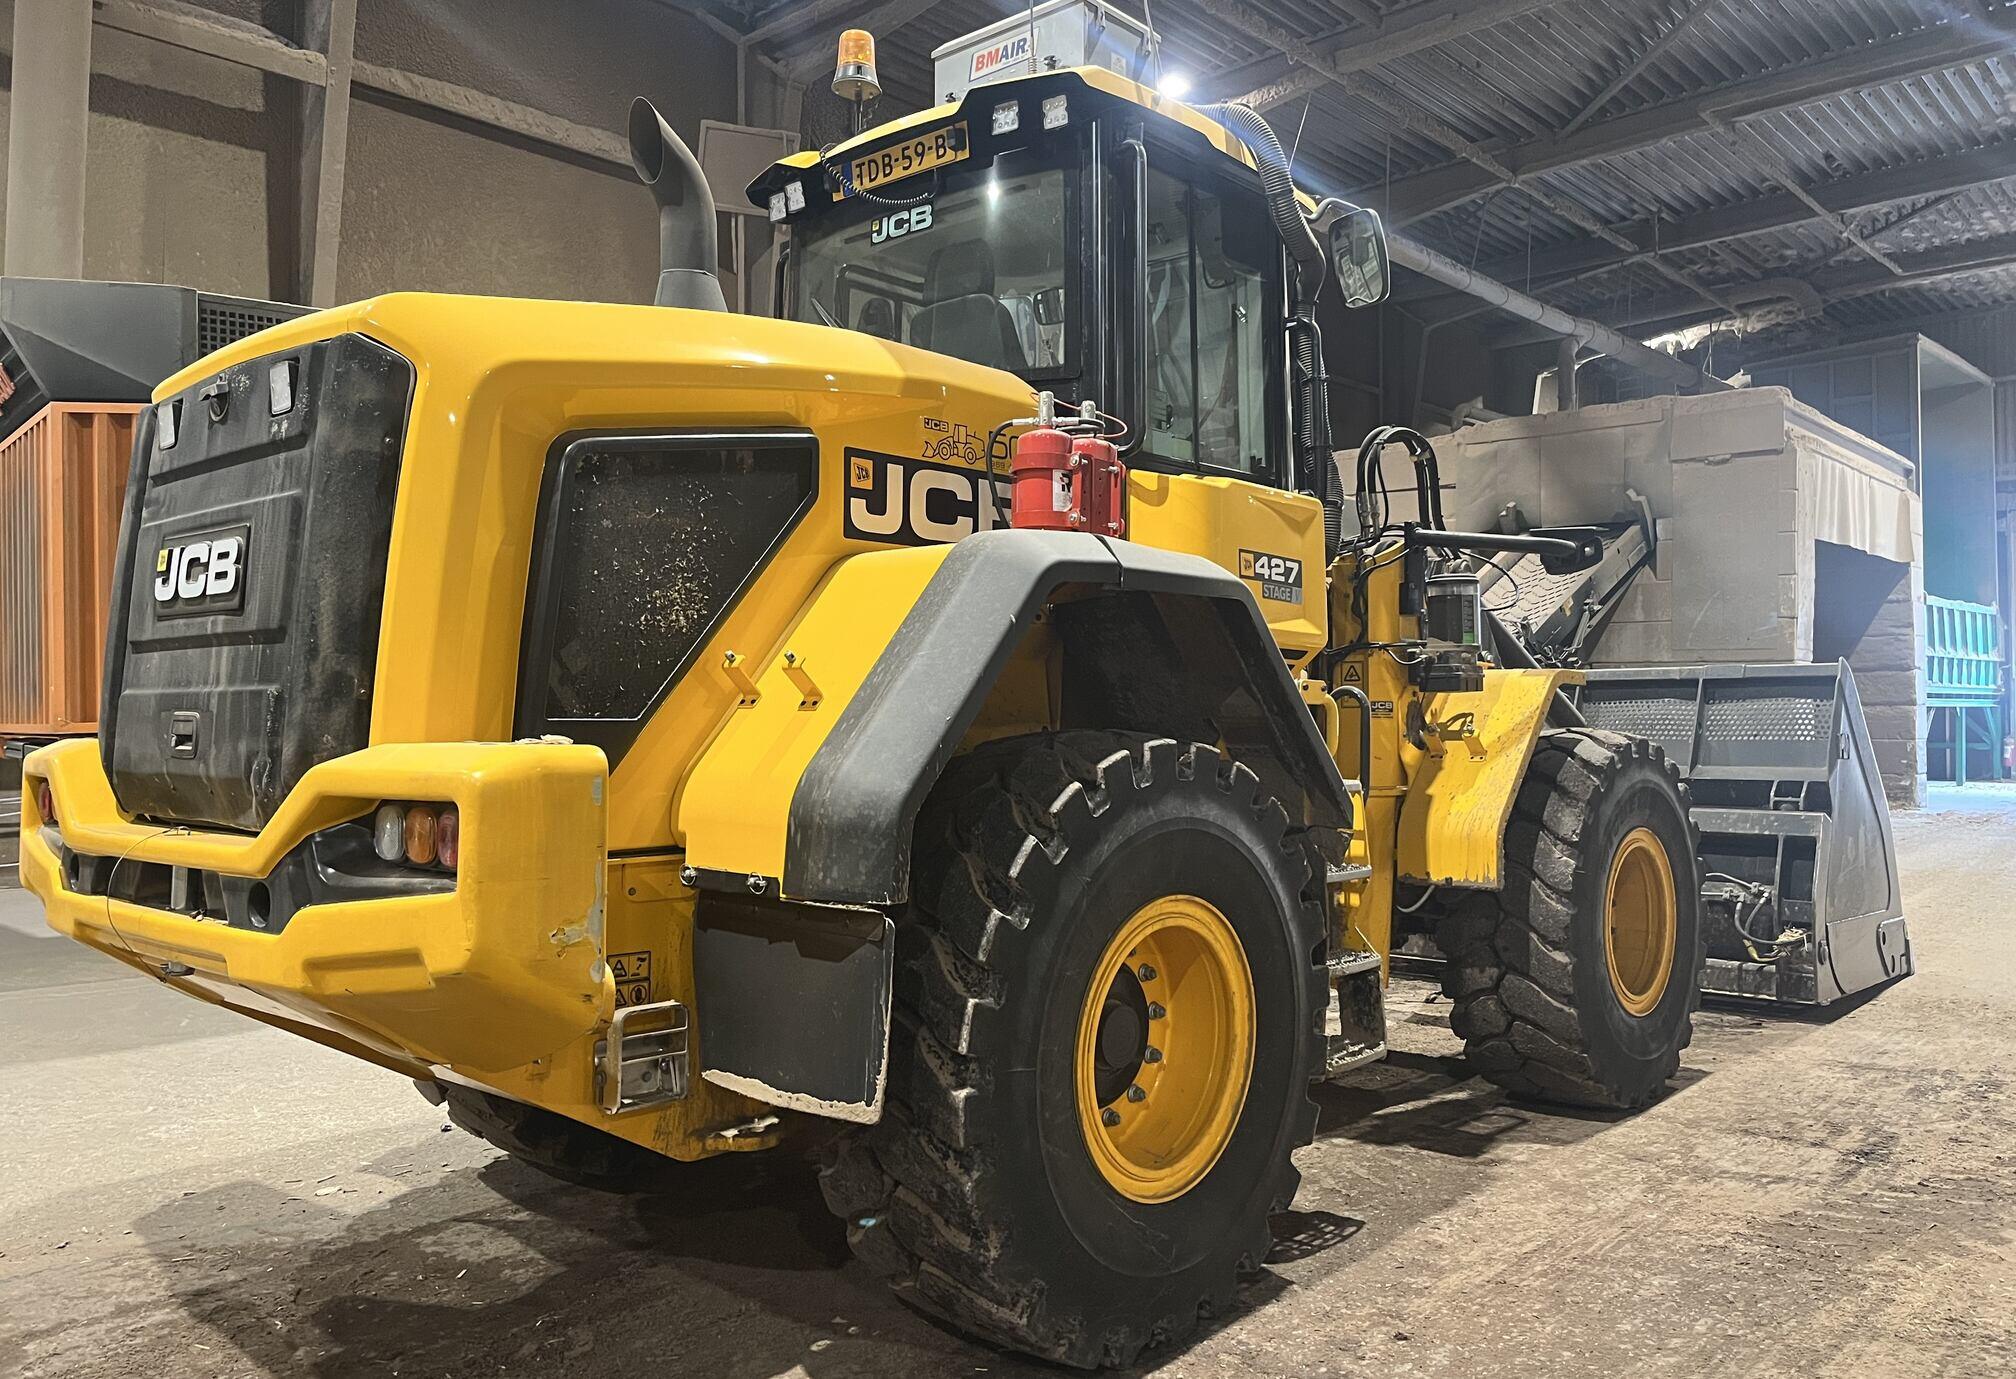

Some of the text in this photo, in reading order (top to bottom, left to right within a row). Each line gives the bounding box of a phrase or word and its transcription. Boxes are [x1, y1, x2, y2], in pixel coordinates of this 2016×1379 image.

[855, 134, 947, 187] TDB-59-B
[871, 204, 933, 244] JCB
[925, 419, 949, 432] JCB
[155, 537, 239, 602] JCB
[1255, 555, 1300, 584] 427
[1263, 584, 1291, 601] STAGE
